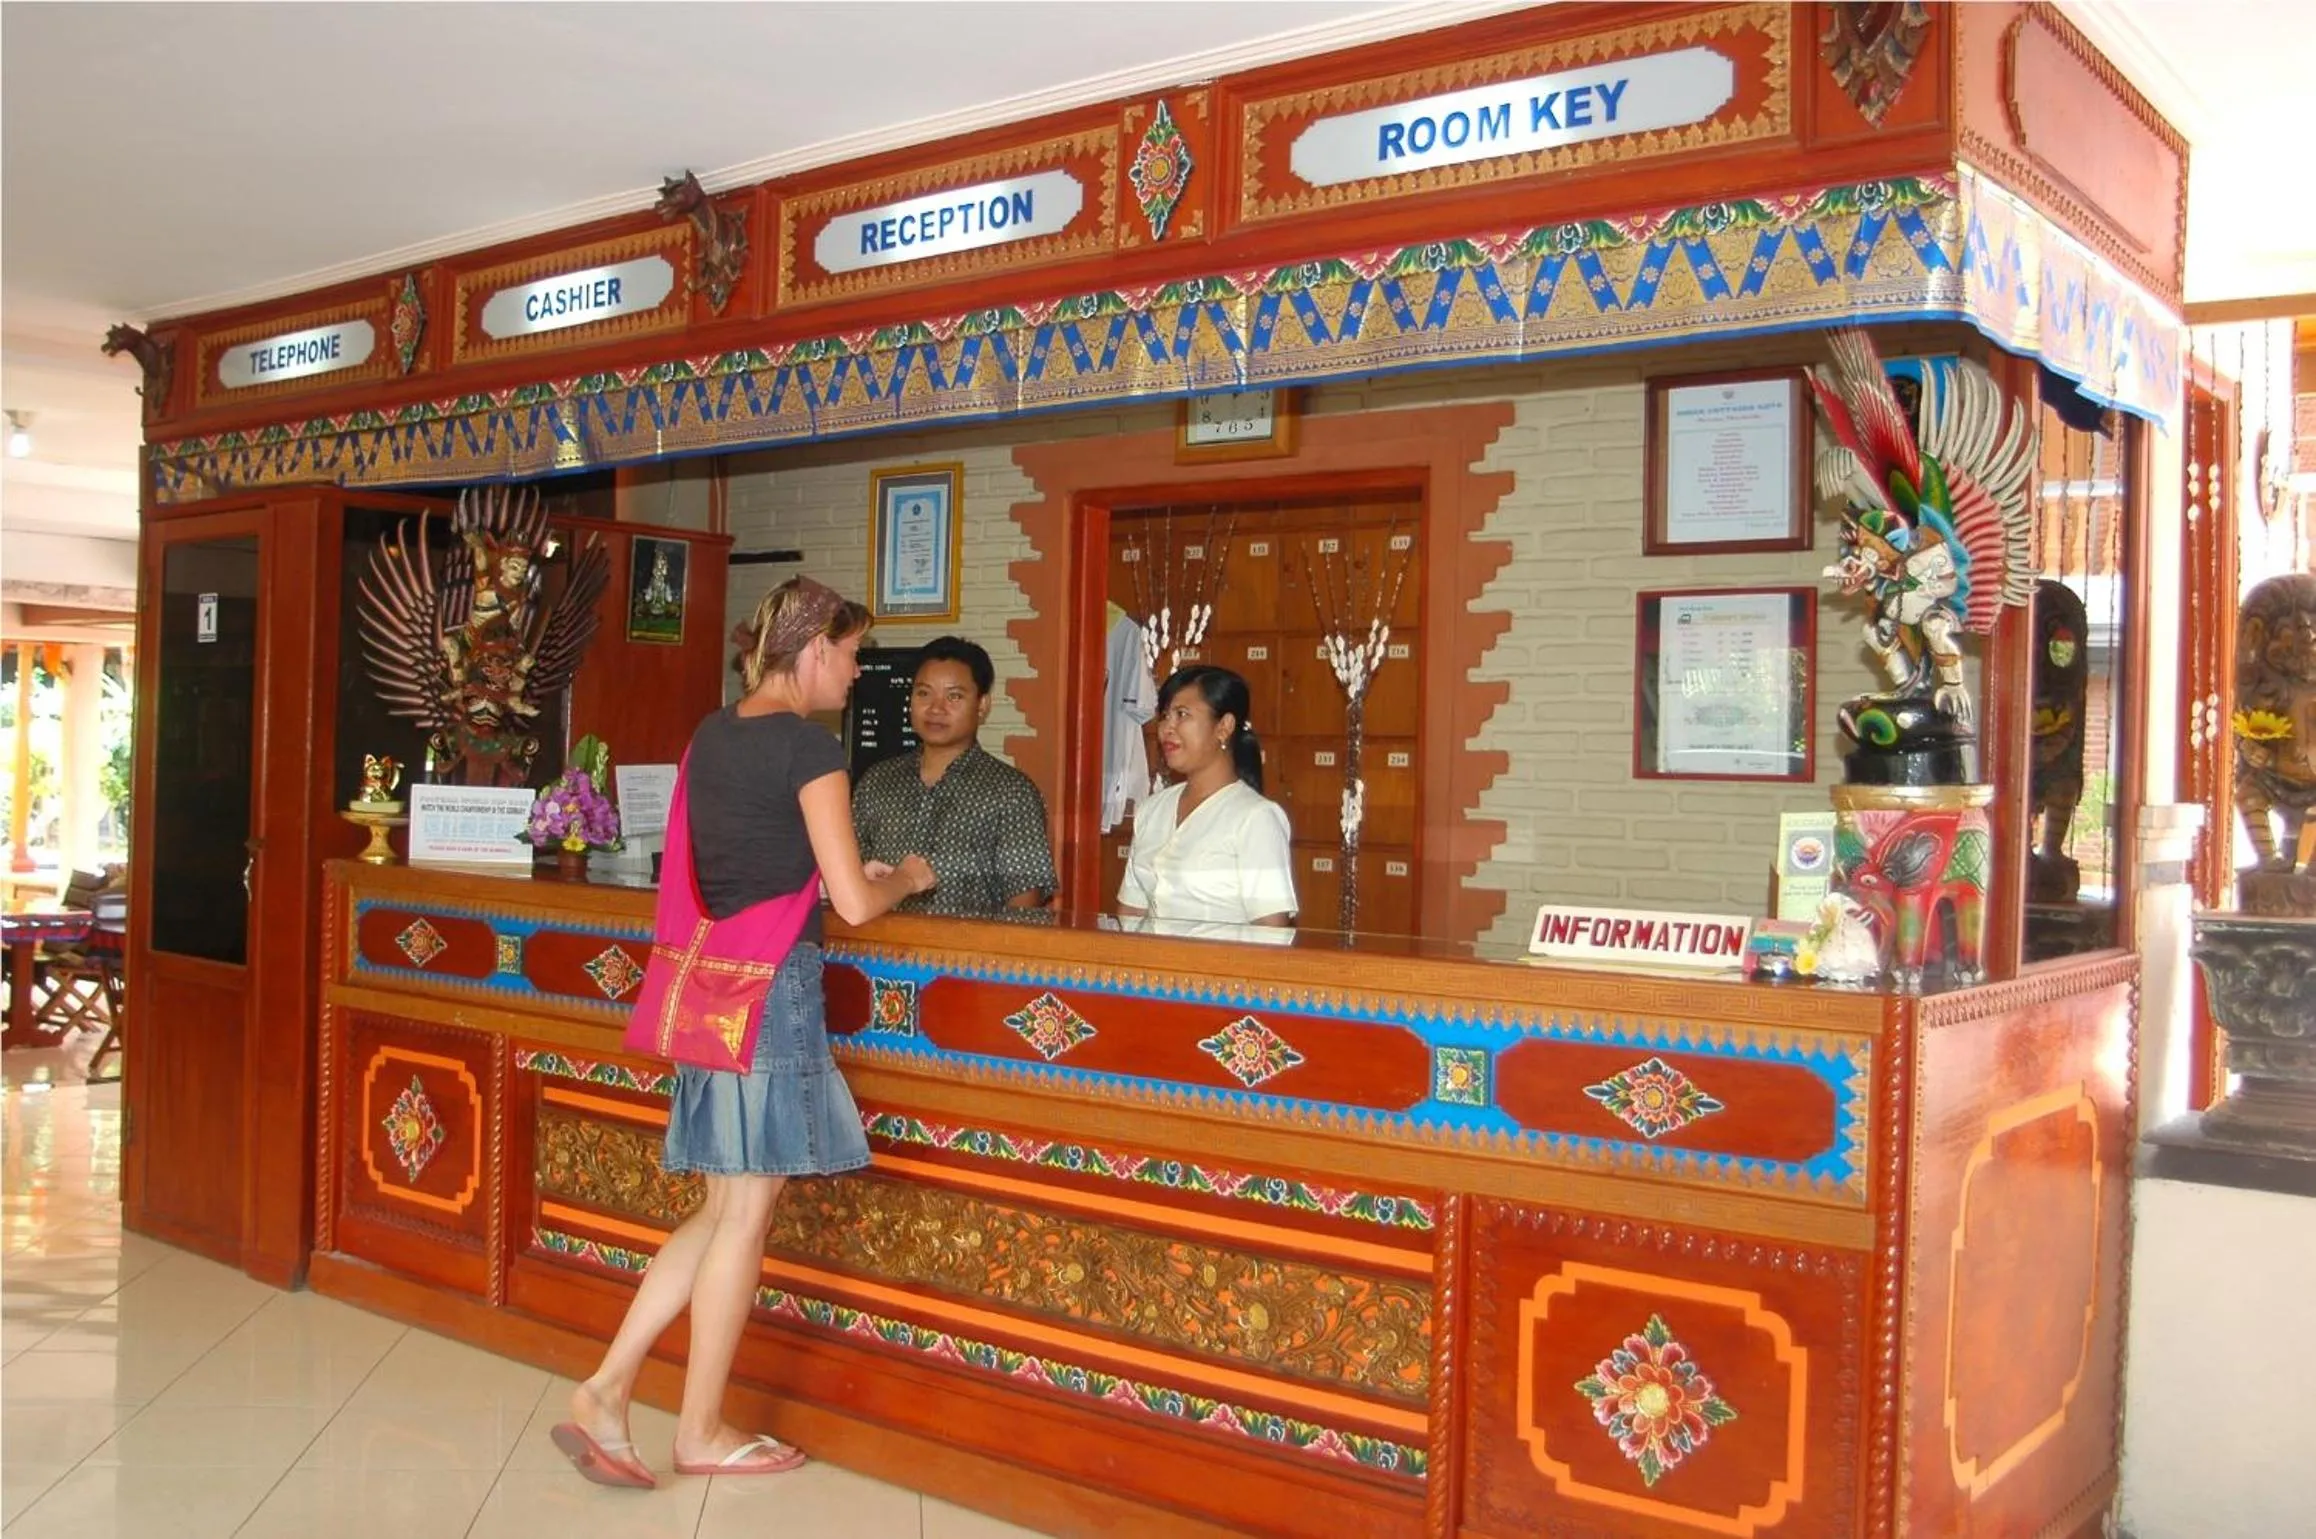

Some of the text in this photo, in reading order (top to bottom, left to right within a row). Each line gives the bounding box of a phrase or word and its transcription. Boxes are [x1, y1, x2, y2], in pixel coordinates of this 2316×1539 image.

[1378, 79, 1628, 161] ROOM KEY
[861, 189, 1033, 255] RECEPTION
[526, 277, 621, 322] CASHIER
[250, 334, 341, 375] TELEPHONE
[204, 606, 211, 630] 1
[1538, 913, 1745, 956] INFORMATION
